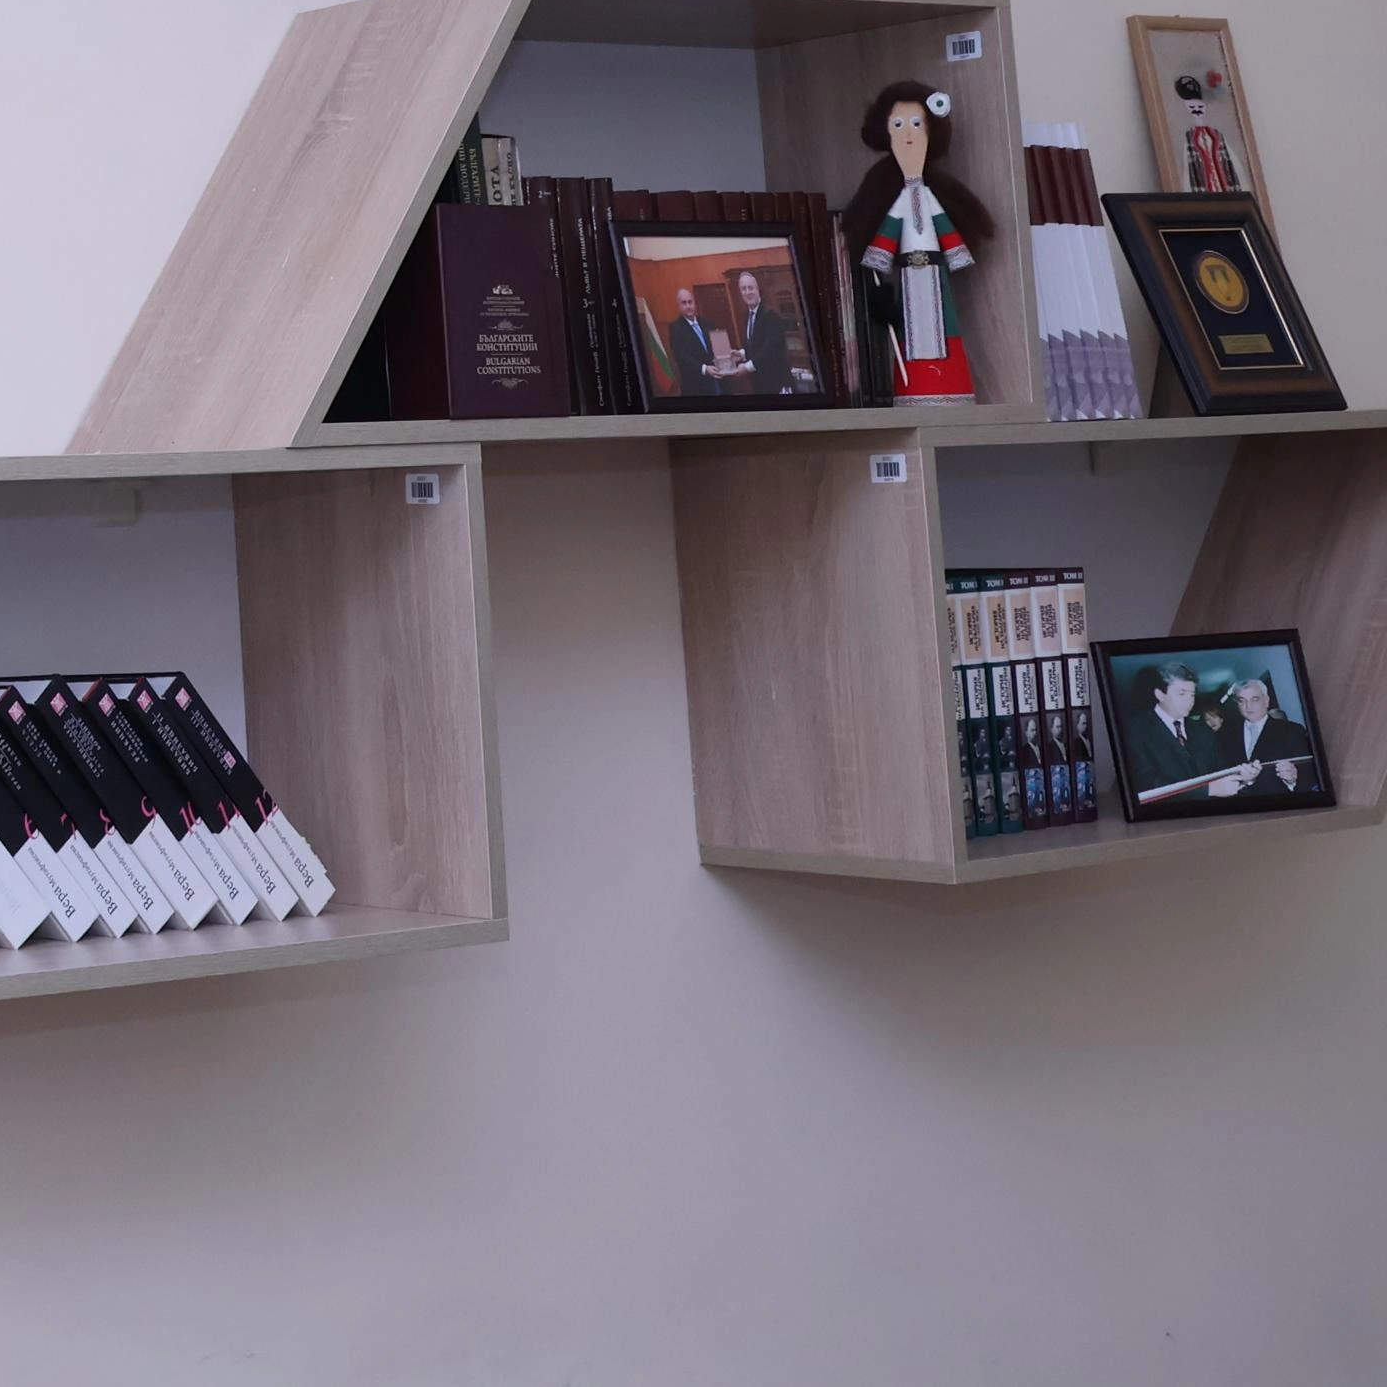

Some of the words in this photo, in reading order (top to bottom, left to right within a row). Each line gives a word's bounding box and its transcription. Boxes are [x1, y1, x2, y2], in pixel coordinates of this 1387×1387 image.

[478, 334, 534, 343] БЪЛГАРСКИТЕ
[476, 343, 539, 352] КОНСТИТУЦИИ
[486, 357, 531, 366] BULGARIAN
[476, 366, 542, 375] CONSTITUTIONS
[1035, 575, 1048, 583] ТОМ
[1062, 572, 1076, 580] ТОМ
[960, 581, 975, 589] ТОМ
[986, 579, 1001, 588] ТОМ
[1009, 578, 1023, 586] ТОМ
[294, 856, 314, 889] Вера
[256, 862, 276, 895] Вера
[173, 868, 195, 901] Вера
[219, 867, 240, 901] Вера
[96, 883, 118, 915] Вера
[132, 879, 154, 912] Вера
[53, 886, 76, 919] Вера
